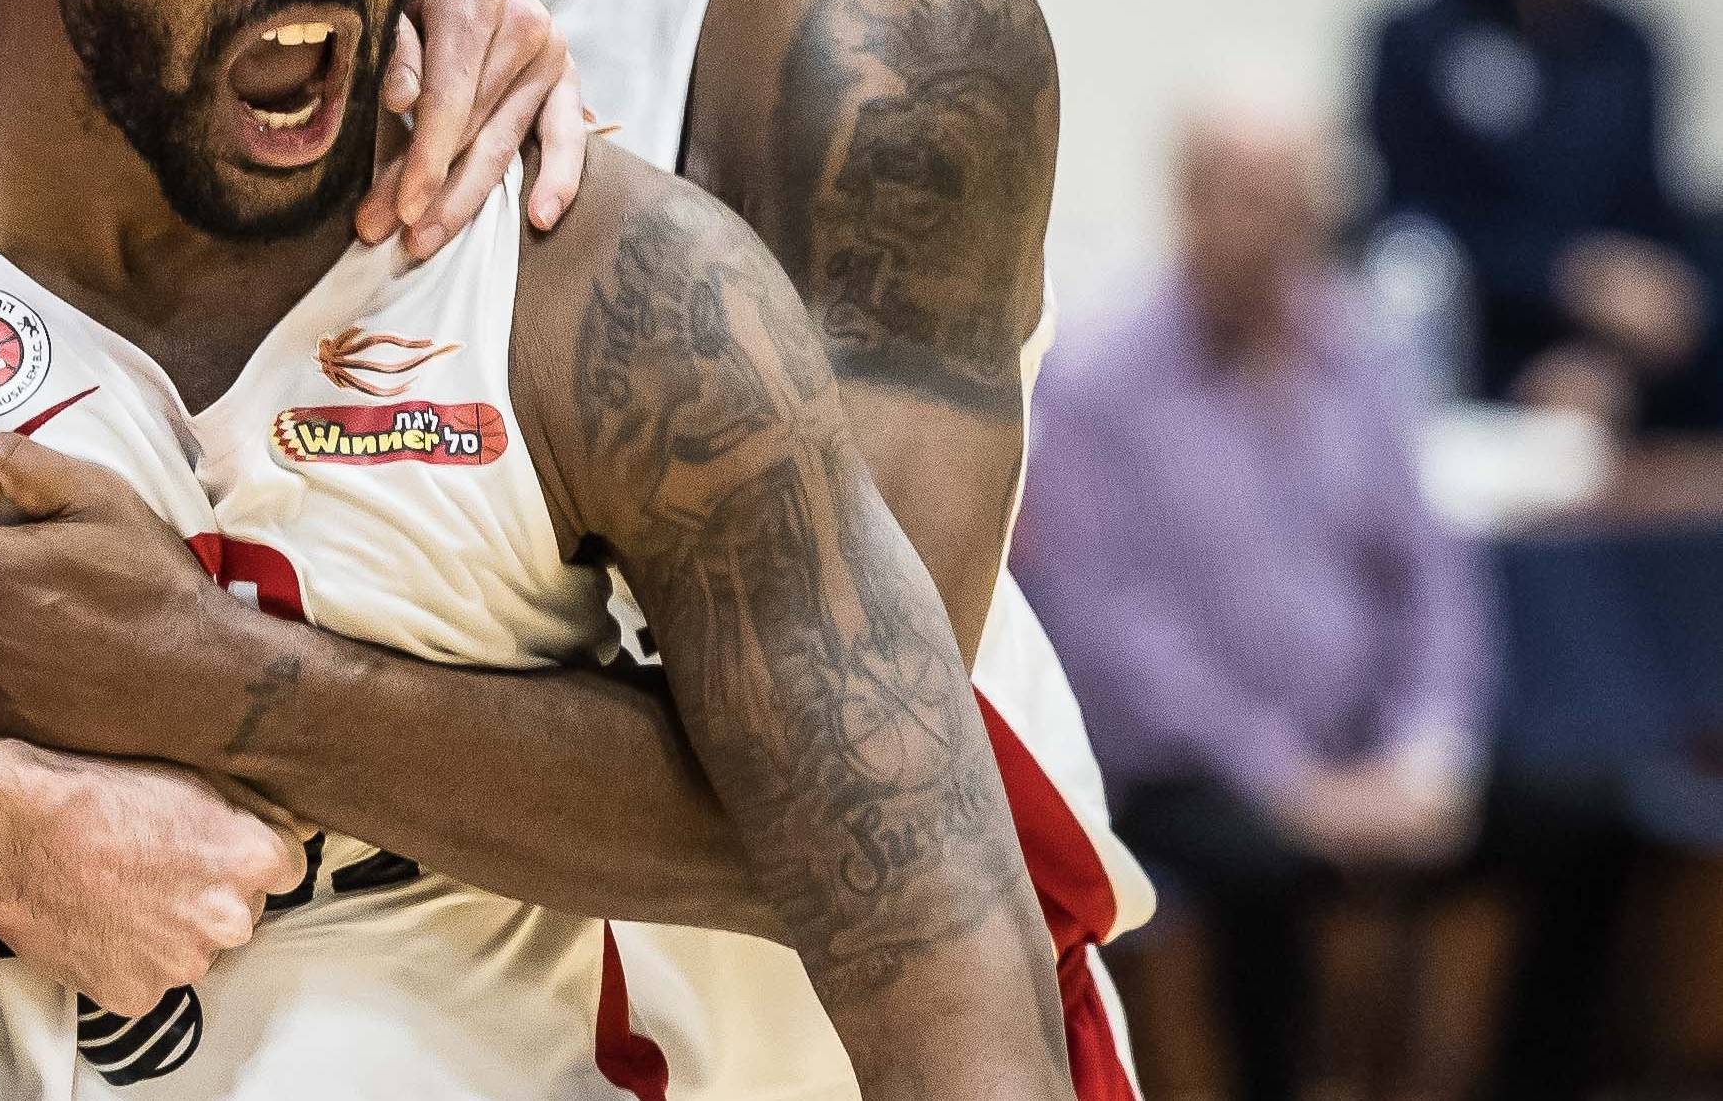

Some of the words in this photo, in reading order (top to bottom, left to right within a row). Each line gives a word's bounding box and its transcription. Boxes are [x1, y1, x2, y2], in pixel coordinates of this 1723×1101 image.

[394, 408, 439, 432] ליגת
[297, 423, 440, 455] Winner
[443, 426, 479, 454] סל
